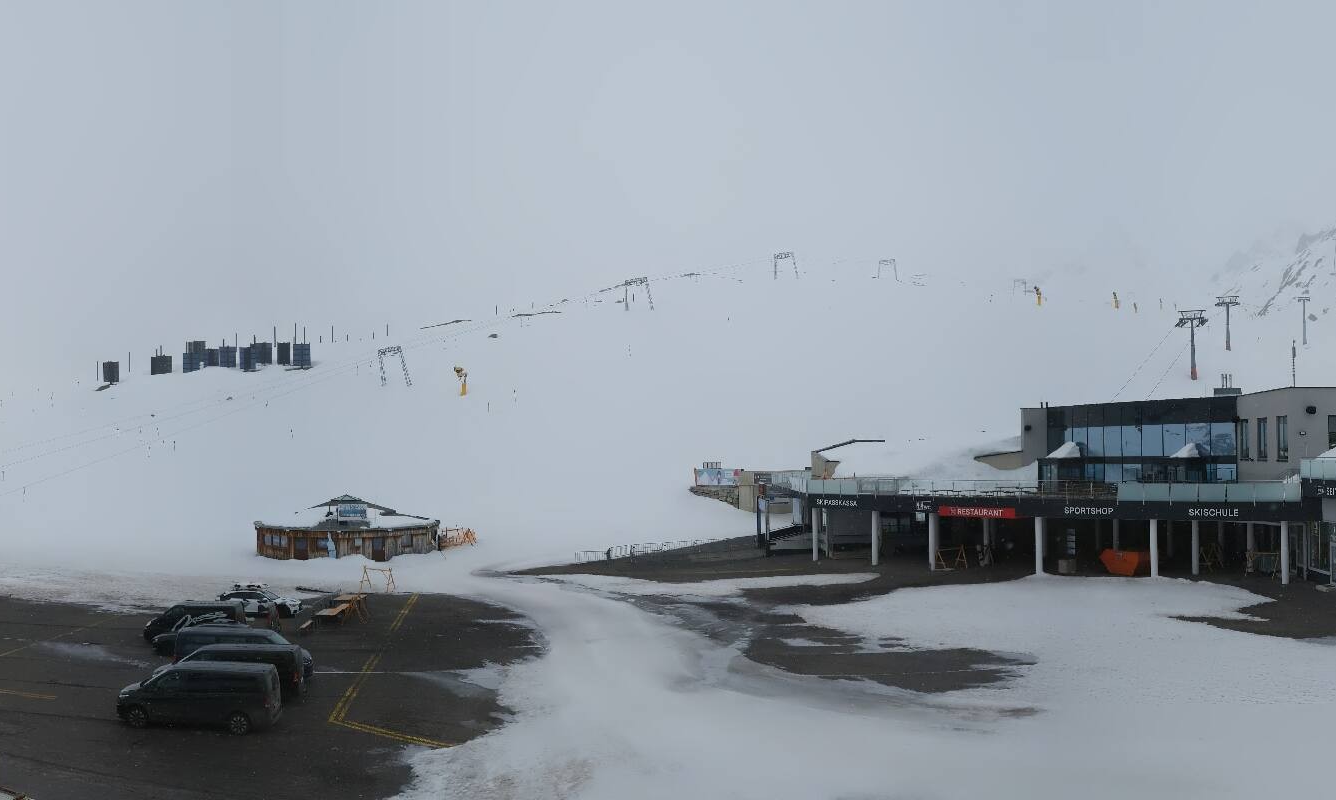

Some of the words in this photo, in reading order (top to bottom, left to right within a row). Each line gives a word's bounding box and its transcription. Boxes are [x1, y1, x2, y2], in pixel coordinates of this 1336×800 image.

[816, 498, 858, 507] SKIPASSKASSA
[957, 507, 1004, 517] RESTAURANT
[1064, 506, 1114, 515] SPORTSHOP
[1188, 508, 1239, 517] SKISCHULE
